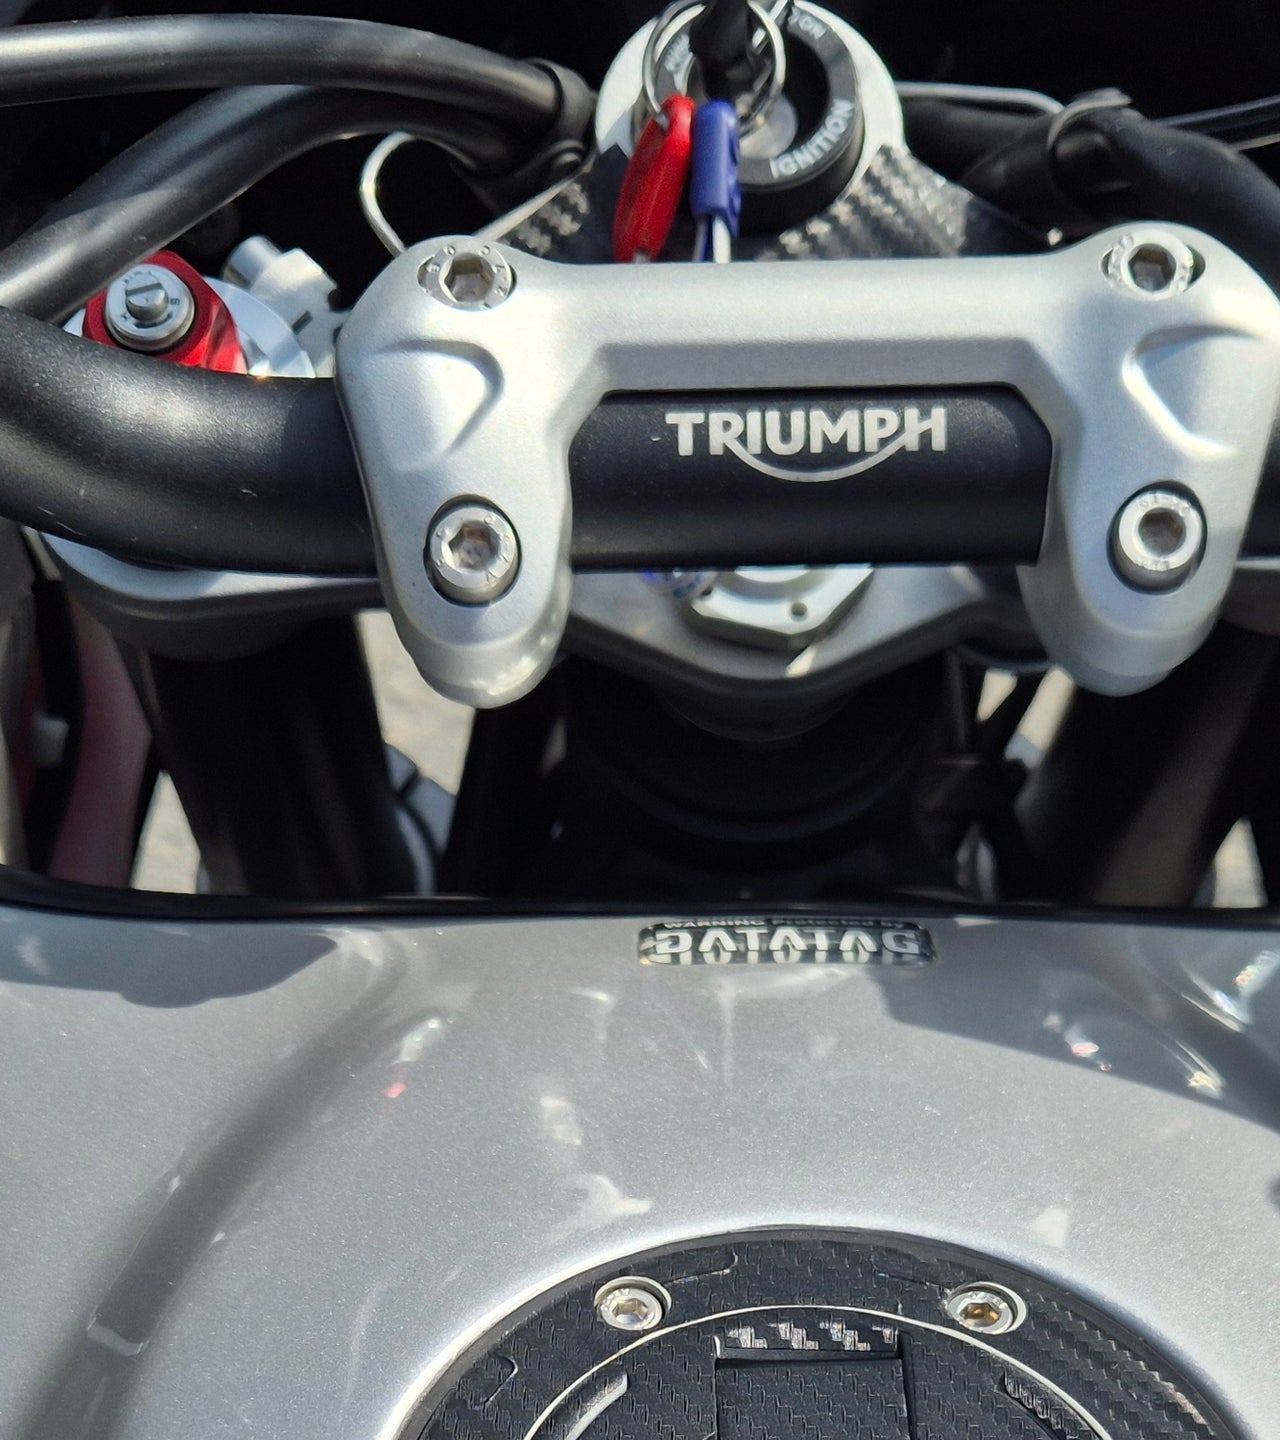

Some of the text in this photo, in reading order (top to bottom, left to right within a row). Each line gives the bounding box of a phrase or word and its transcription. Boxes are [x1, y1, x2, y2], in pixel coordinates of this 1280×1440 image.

[769, 98, 854, 179] IGNITION
[665, 406, 947, 482] TRIUMPH
[654, 926, 920, 954] DATATAG
[663, 918, 766, 929] WARNING
